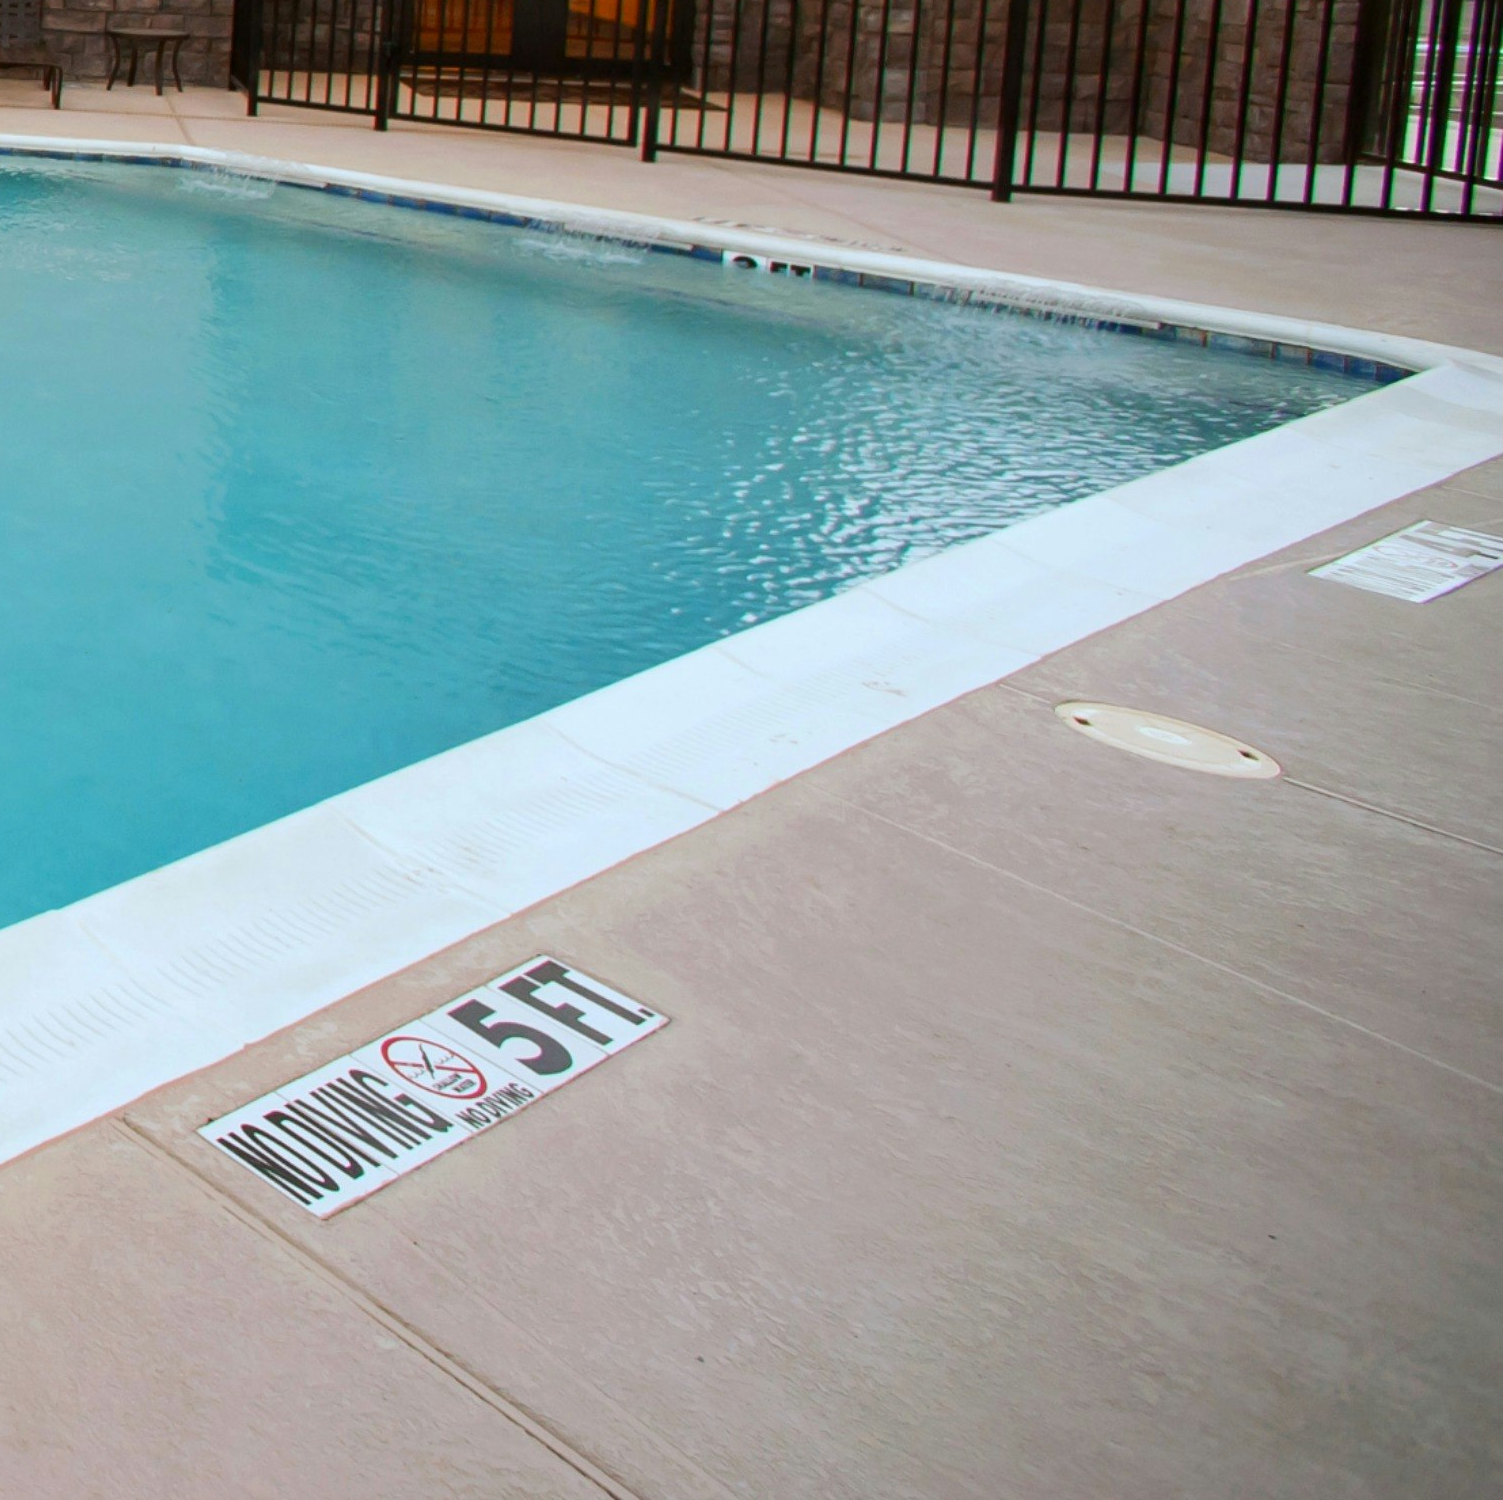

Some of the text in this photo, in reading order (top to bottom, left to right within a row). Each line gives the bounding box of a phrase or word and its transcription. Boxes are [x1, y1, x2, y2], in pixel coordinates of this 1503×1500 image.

[447, 960, 655, 1076] 5 FT.
[216, 1069, 454, 1205] NO DIVING
[455, 1082, 535, 1129] NO DIVING
